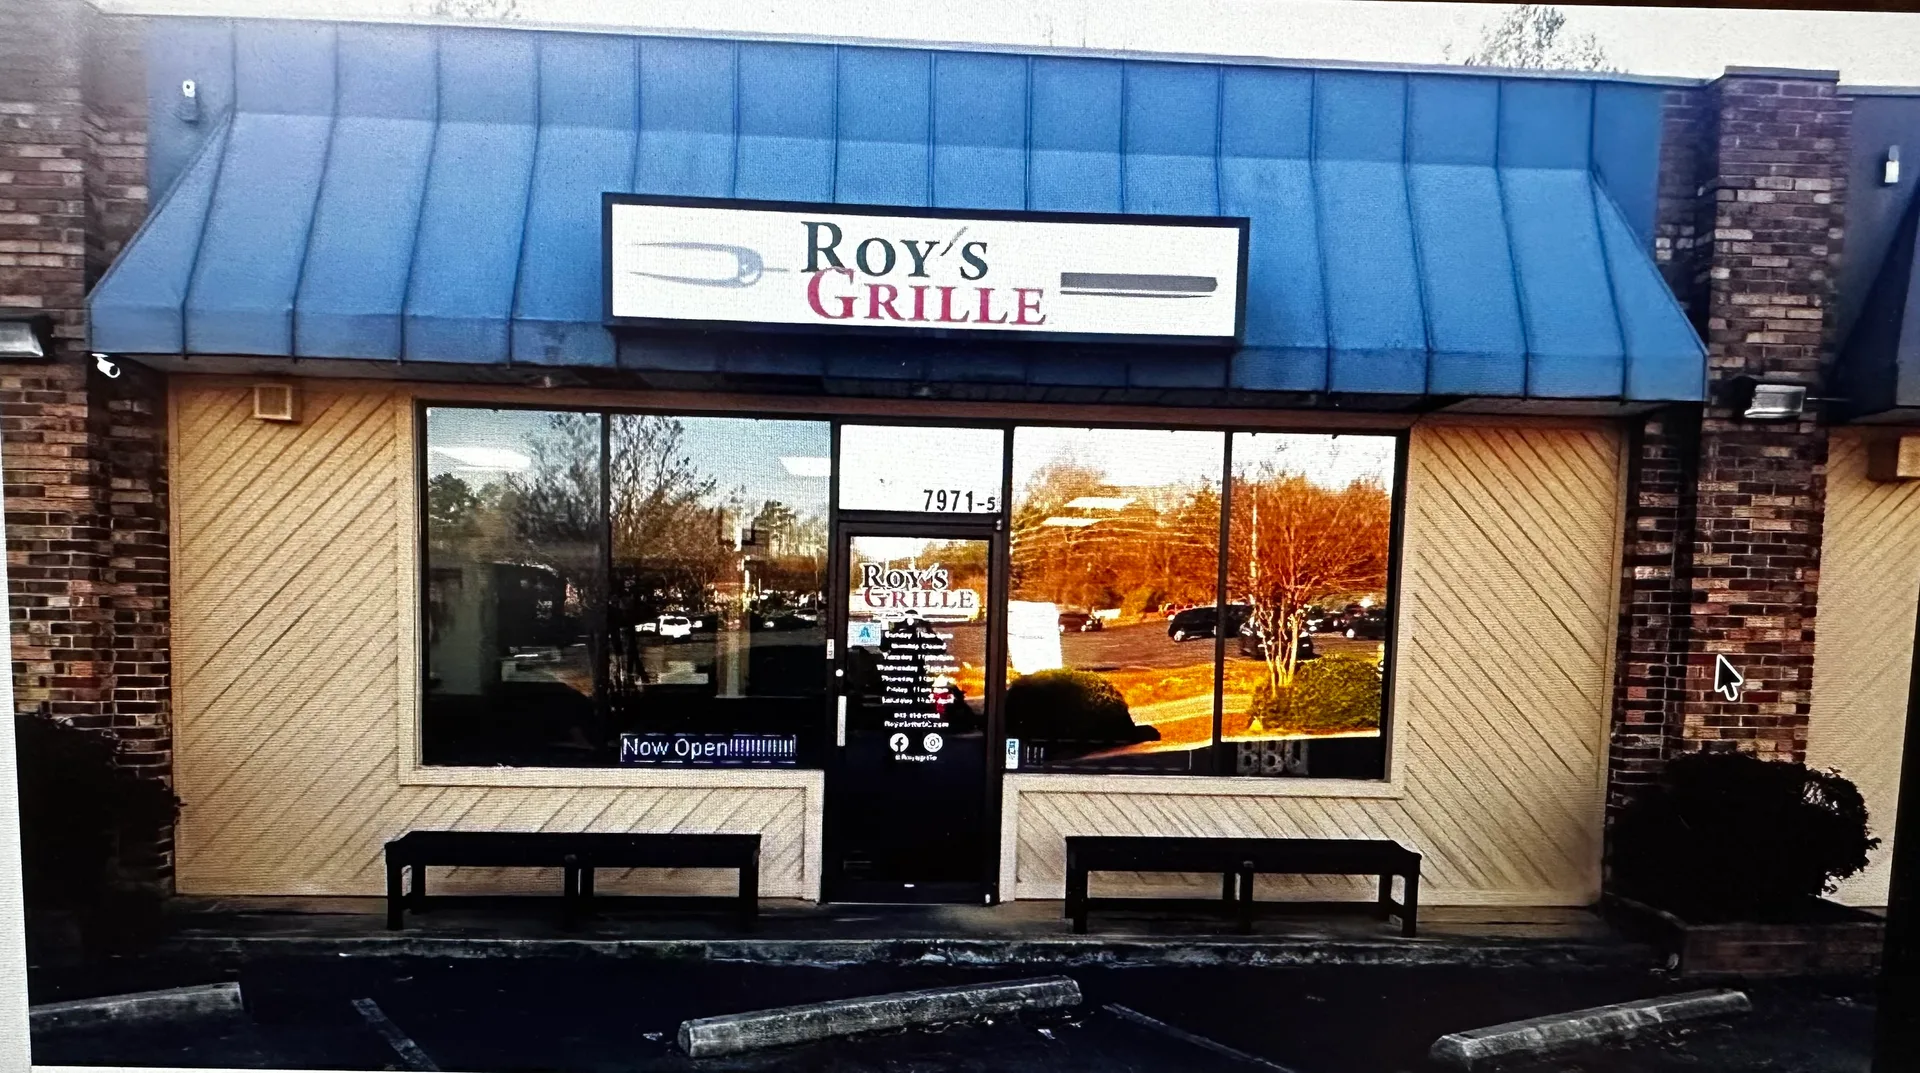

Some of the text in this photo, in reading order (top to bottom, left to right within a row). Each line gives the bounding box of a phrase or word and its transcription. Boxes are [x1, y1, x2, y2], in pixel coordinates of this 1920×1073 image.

[807, 266, 1046, 325] GRILLE
[923, 489, 996, 513] 7971-5
[864, 587, 974, 609] GRILLE
[623, 738, 669, 756] Now
